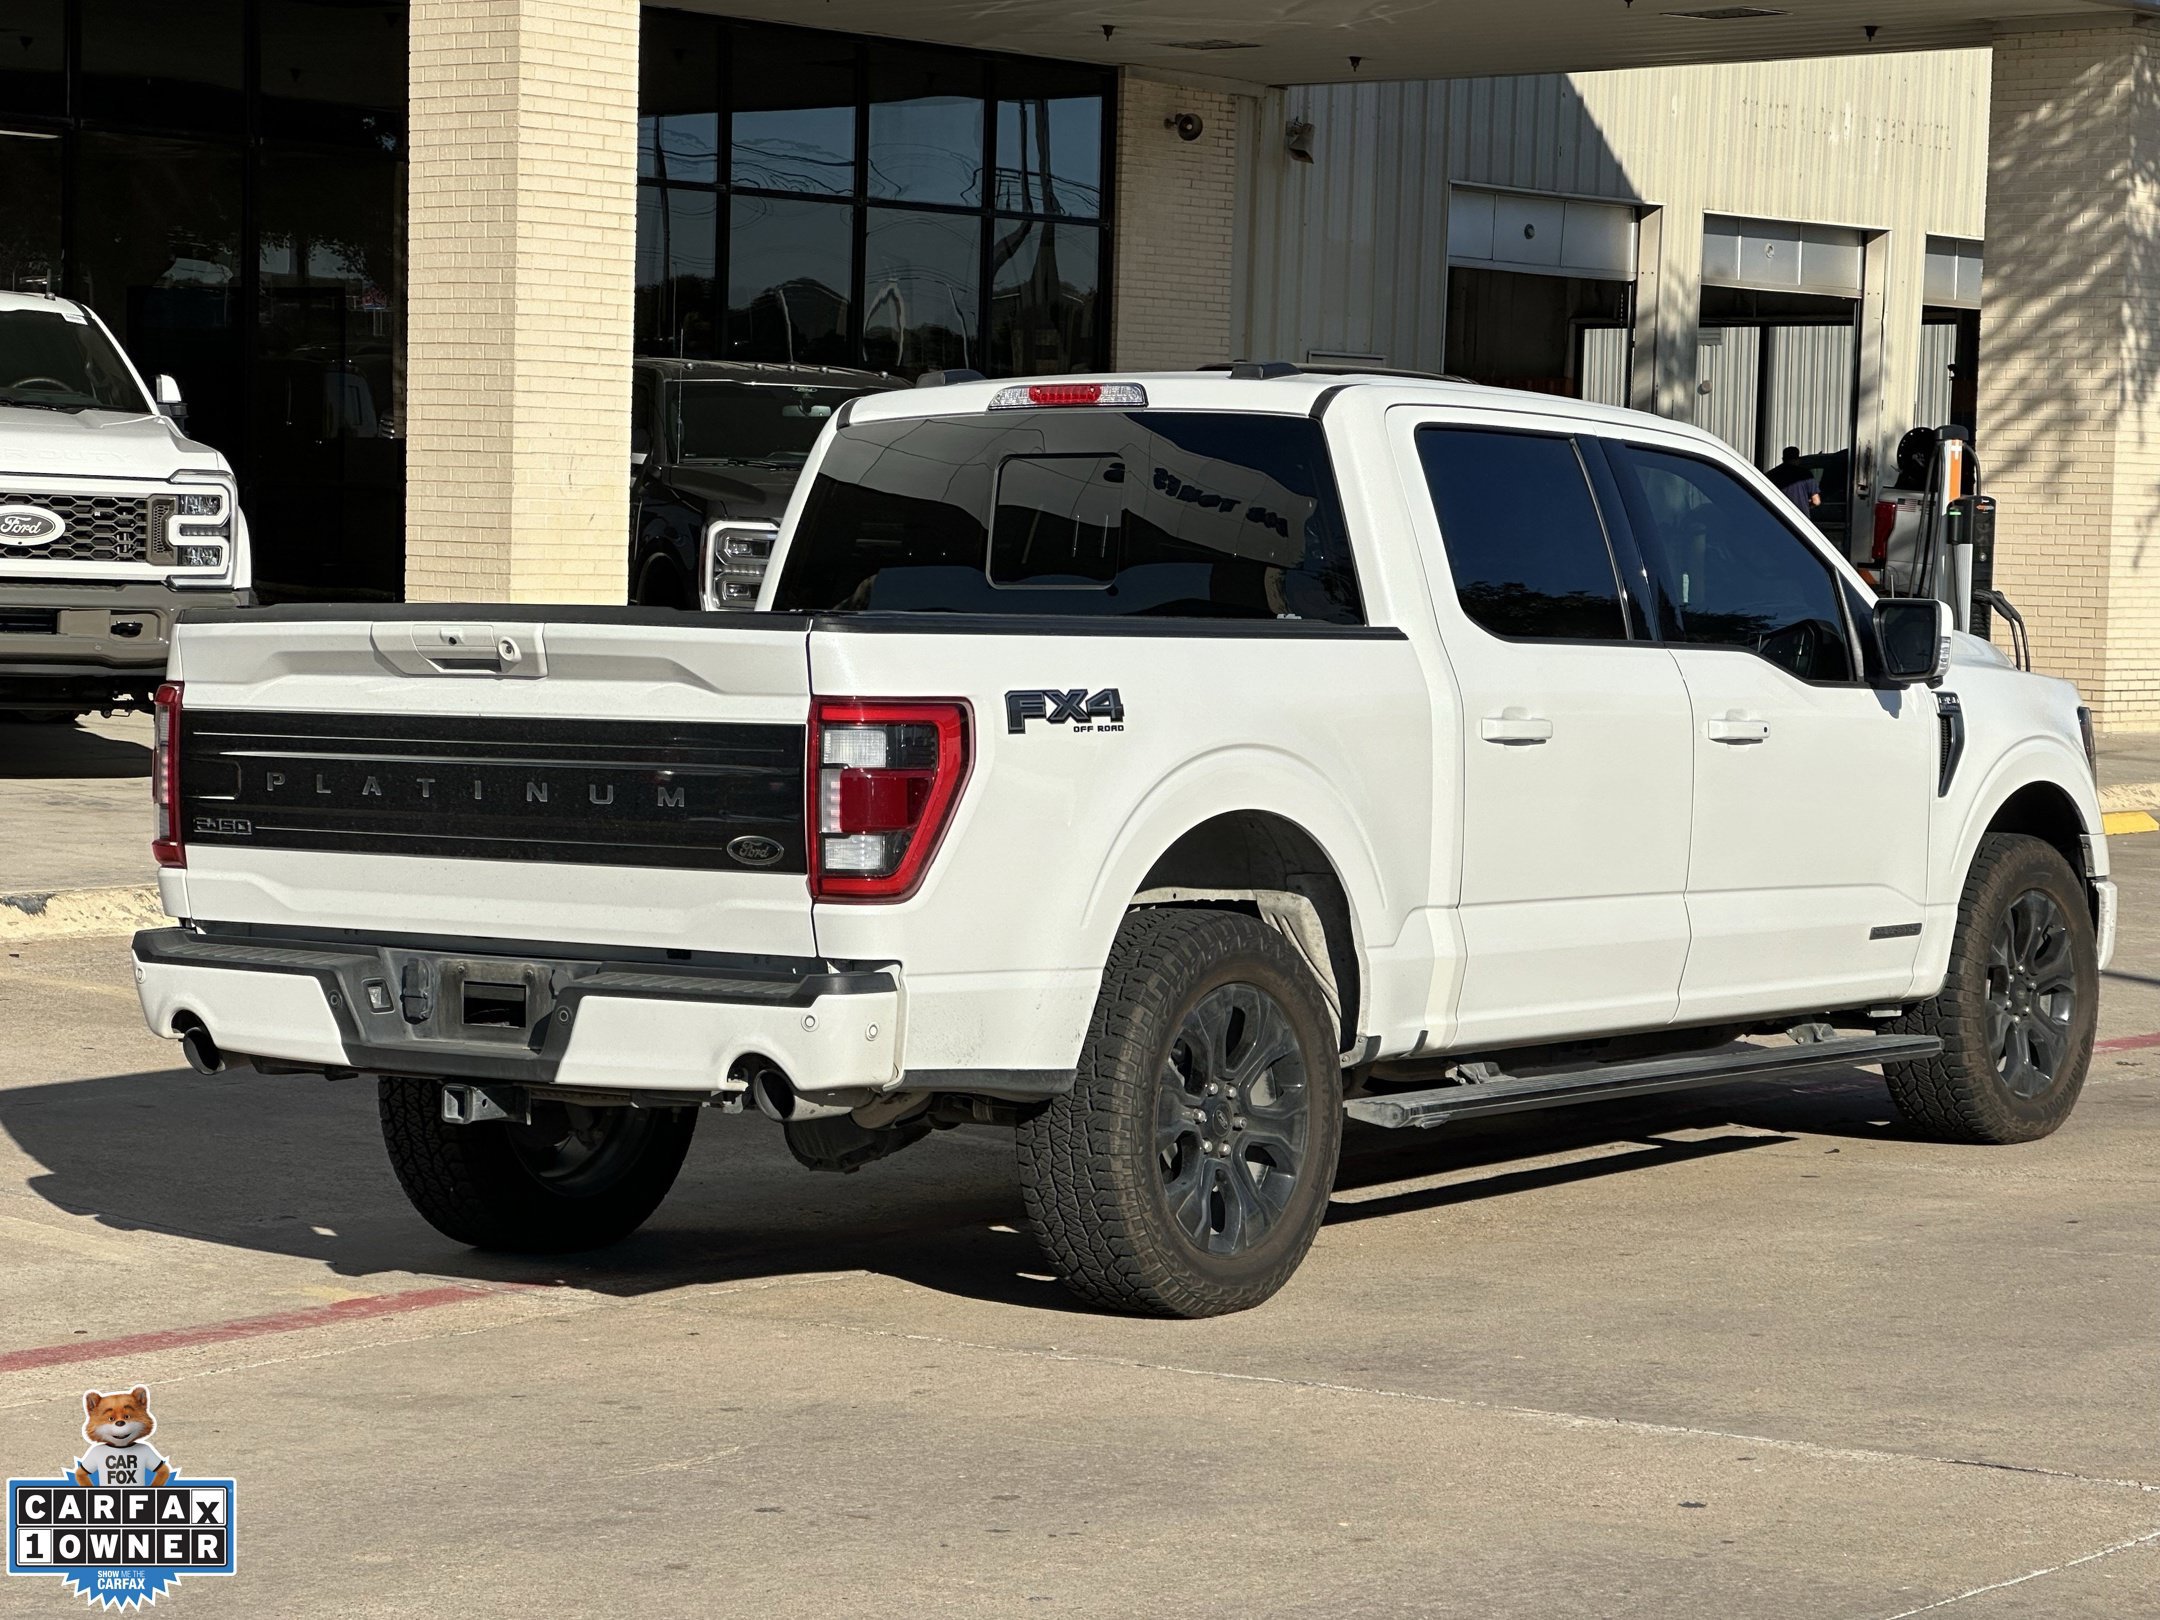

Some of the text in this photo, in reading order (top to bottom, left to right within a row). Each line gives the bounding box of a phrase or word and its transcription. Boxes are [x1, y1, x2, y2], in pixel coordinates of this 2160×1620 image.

[1, 515, 43, 534] Ford
[1004, 688, 1124, 734] FX4
[1073, 724, 1124, 733] OFF ROAD
[266, 770, 685, 808] PLATINUM
